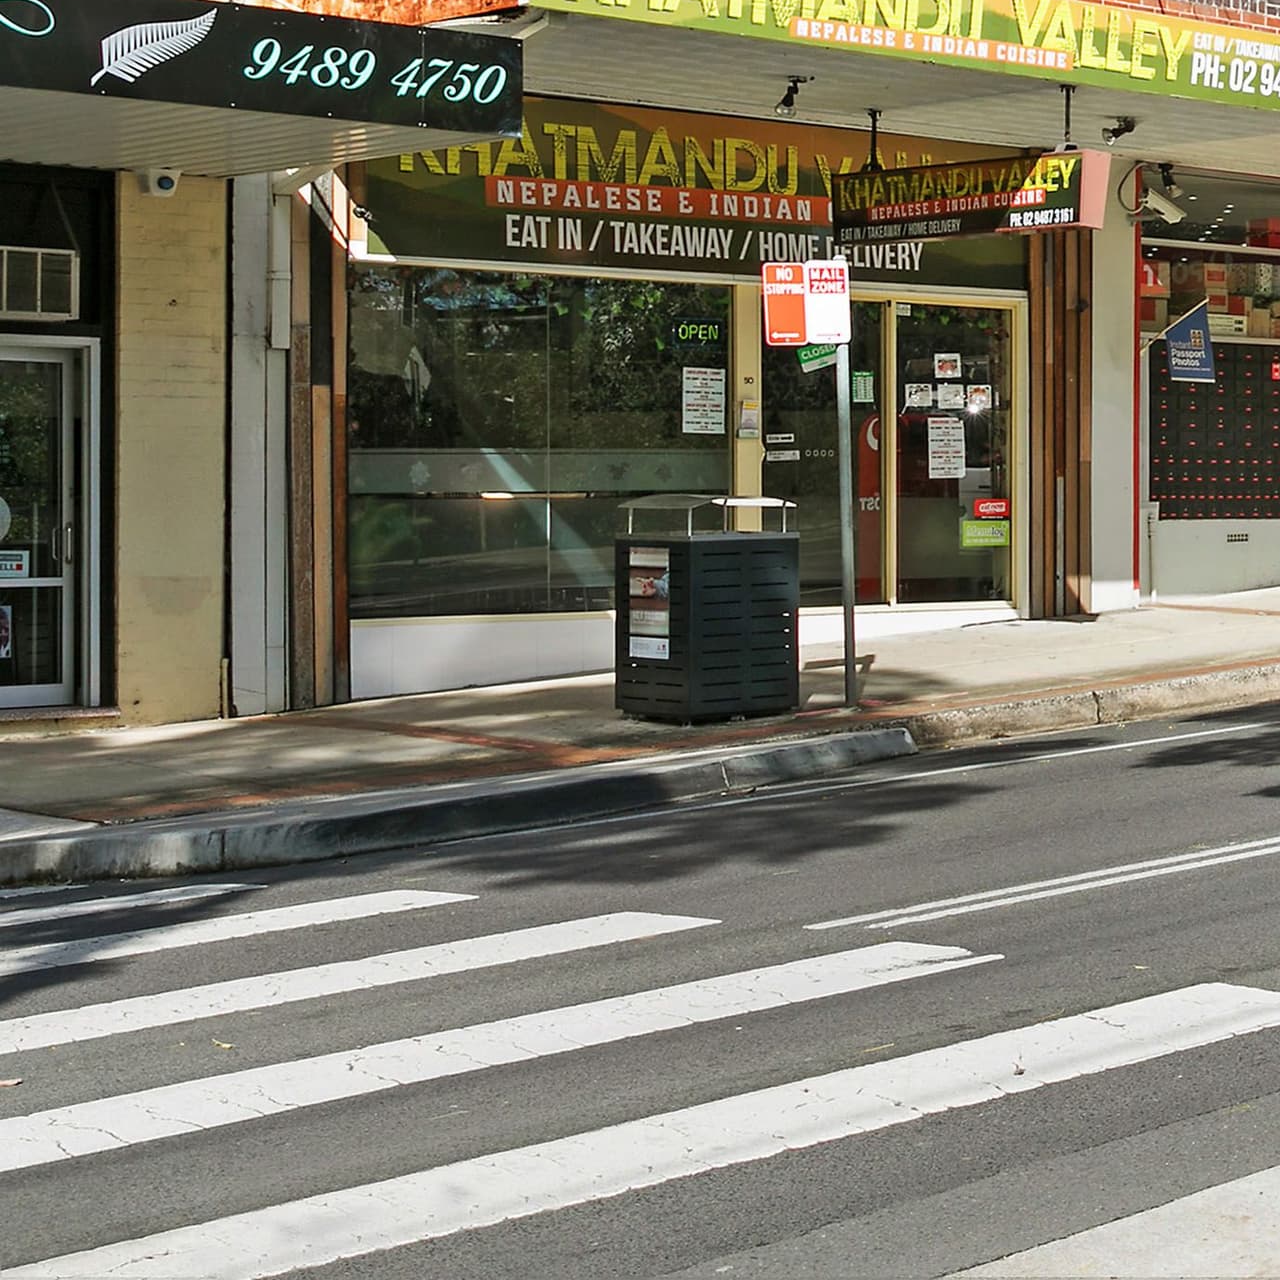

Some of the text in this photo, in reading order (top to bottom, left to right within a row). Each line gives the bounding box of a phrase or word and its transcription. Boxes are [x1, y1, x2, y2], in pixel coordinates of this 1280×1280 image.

[796, 19, 895, 48] NEPALESE
[923, 35, 988, 59] INDIAN
[996, 44, 1068, 69] CUISINE
[1194, 32, 1212, 49] EAT
[1213, 35, 1226, 52] IN
[243, 38, 507, 105] 9489 4750
[1190, 52, 1225, 89] PH:
[1229, 58, 1257, 94] 02
[840, 166, 984, 212] KHATMANDU
[993, 158, 1076, 193] VALLEY
[497, 180, 662, 213] NEPALESE
[710, 193, 811, 222] INDIAN
[871, 201, 929, 221] NEPALESE
[946, 194, 989, 213] INDIAN
[994, 189, 1044, 208] CUISINE
[908, 221, 928, 236] HOME
[929, 218, 961, 234] DELIVERY
[506, 214, 924, 271] EAT IN / TAKEAWAY / HOME DELIVERY
[775, 267, 793, 281] NO
[809, 268, 845, 280] MAIL
[766, 283, 804, 294] STOPPING
[810, 281, 845, 293] ZONE
[678, 324, 719, 341] OPEN
[801, 343, 836, 360] CLOSED
[1171, 348, 1206, 359] Passport
[1172, 357, 1200, 367] Photos
[744, 376, 754, 385] 50
